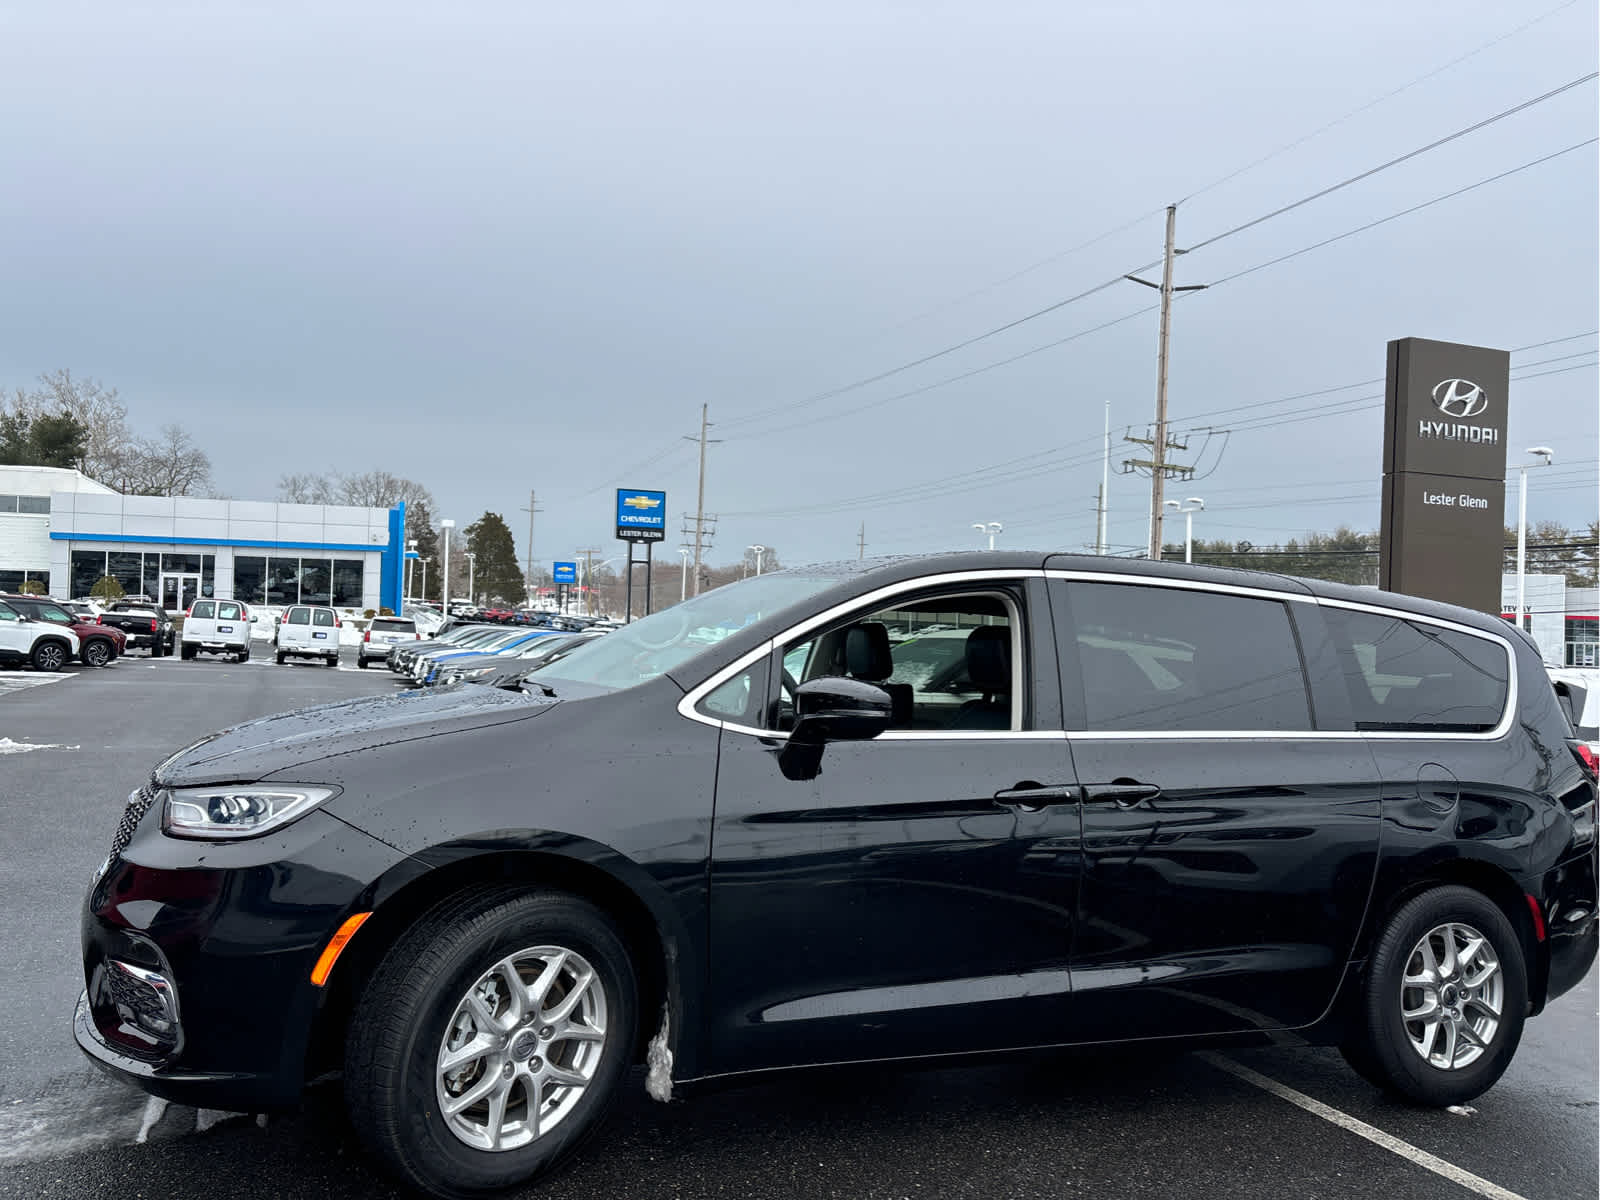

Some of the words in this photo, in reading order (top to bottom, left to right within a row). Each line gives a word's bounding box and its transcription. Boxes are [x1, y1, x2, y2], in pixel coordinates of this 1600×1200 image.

[1419, 420, 1498, 444] HYUNDAI
[1423, 491, 1457, 506] Lester
[1459, 494, 1488, 509] Glenn
[620, 515, 662, 524] CHEVROLET
